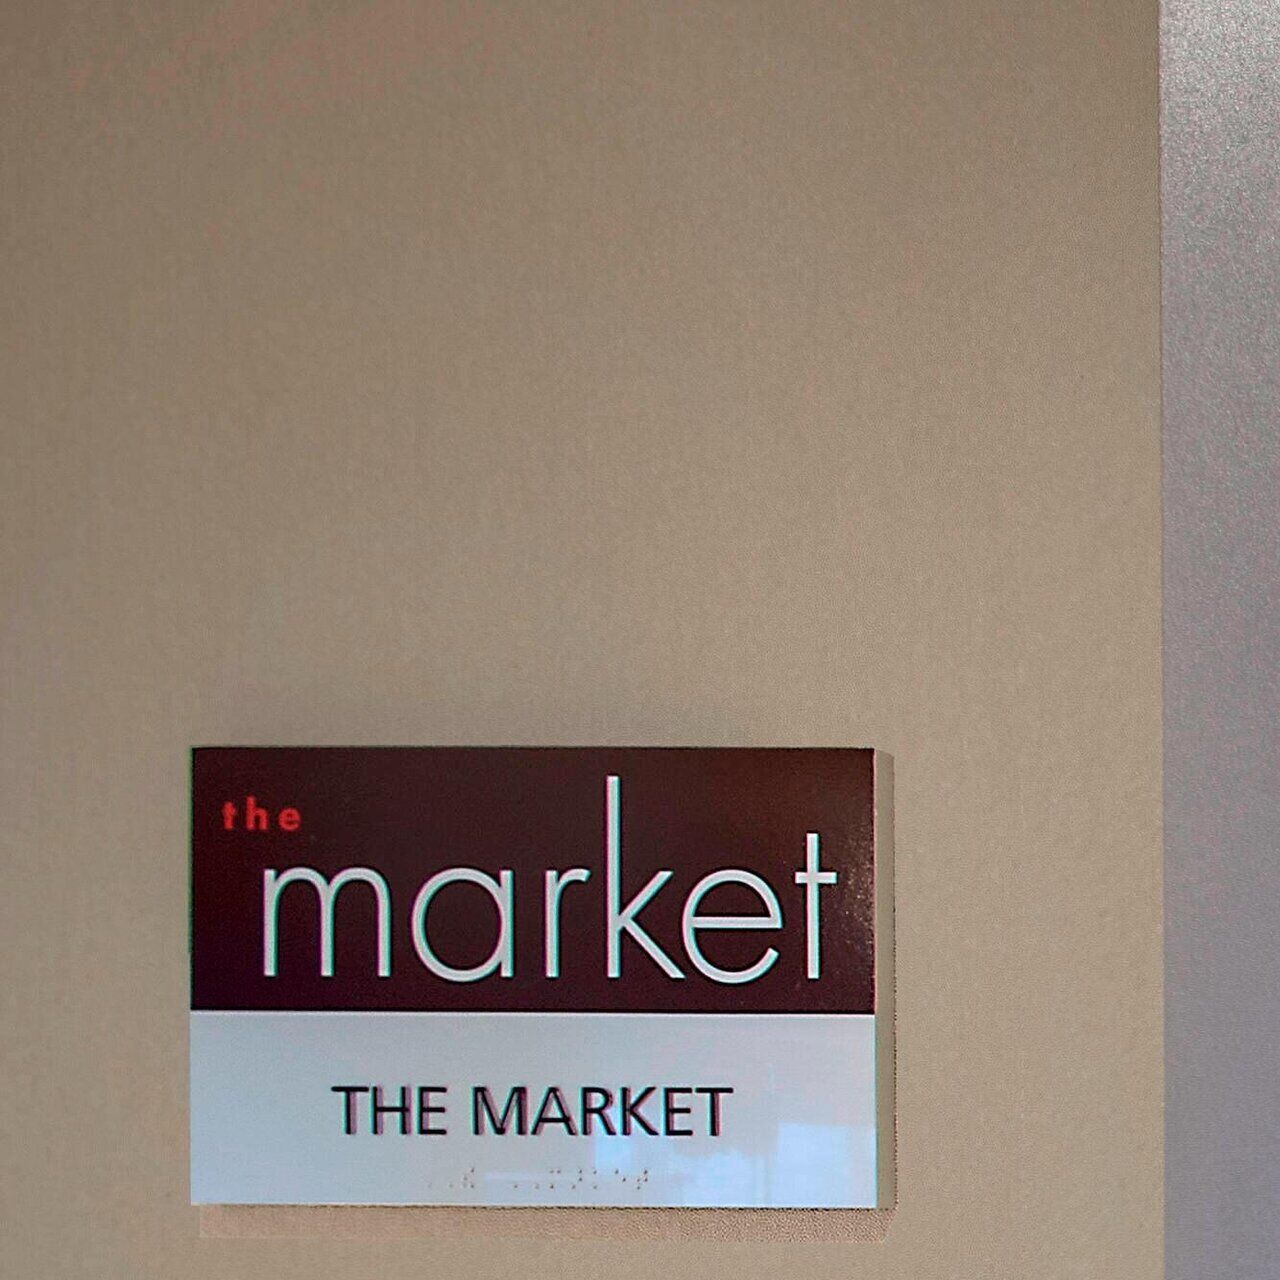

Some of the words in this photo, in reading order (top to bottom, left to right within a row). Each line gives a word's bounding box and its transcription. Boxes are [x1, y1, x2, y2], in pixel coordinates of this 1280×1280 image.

[222, 798, 300, 831] the
[262, 775, 838, 984] market
[331, 1085, 447, 1137] THE
[472, 1085, 735, 1137] MARKET
